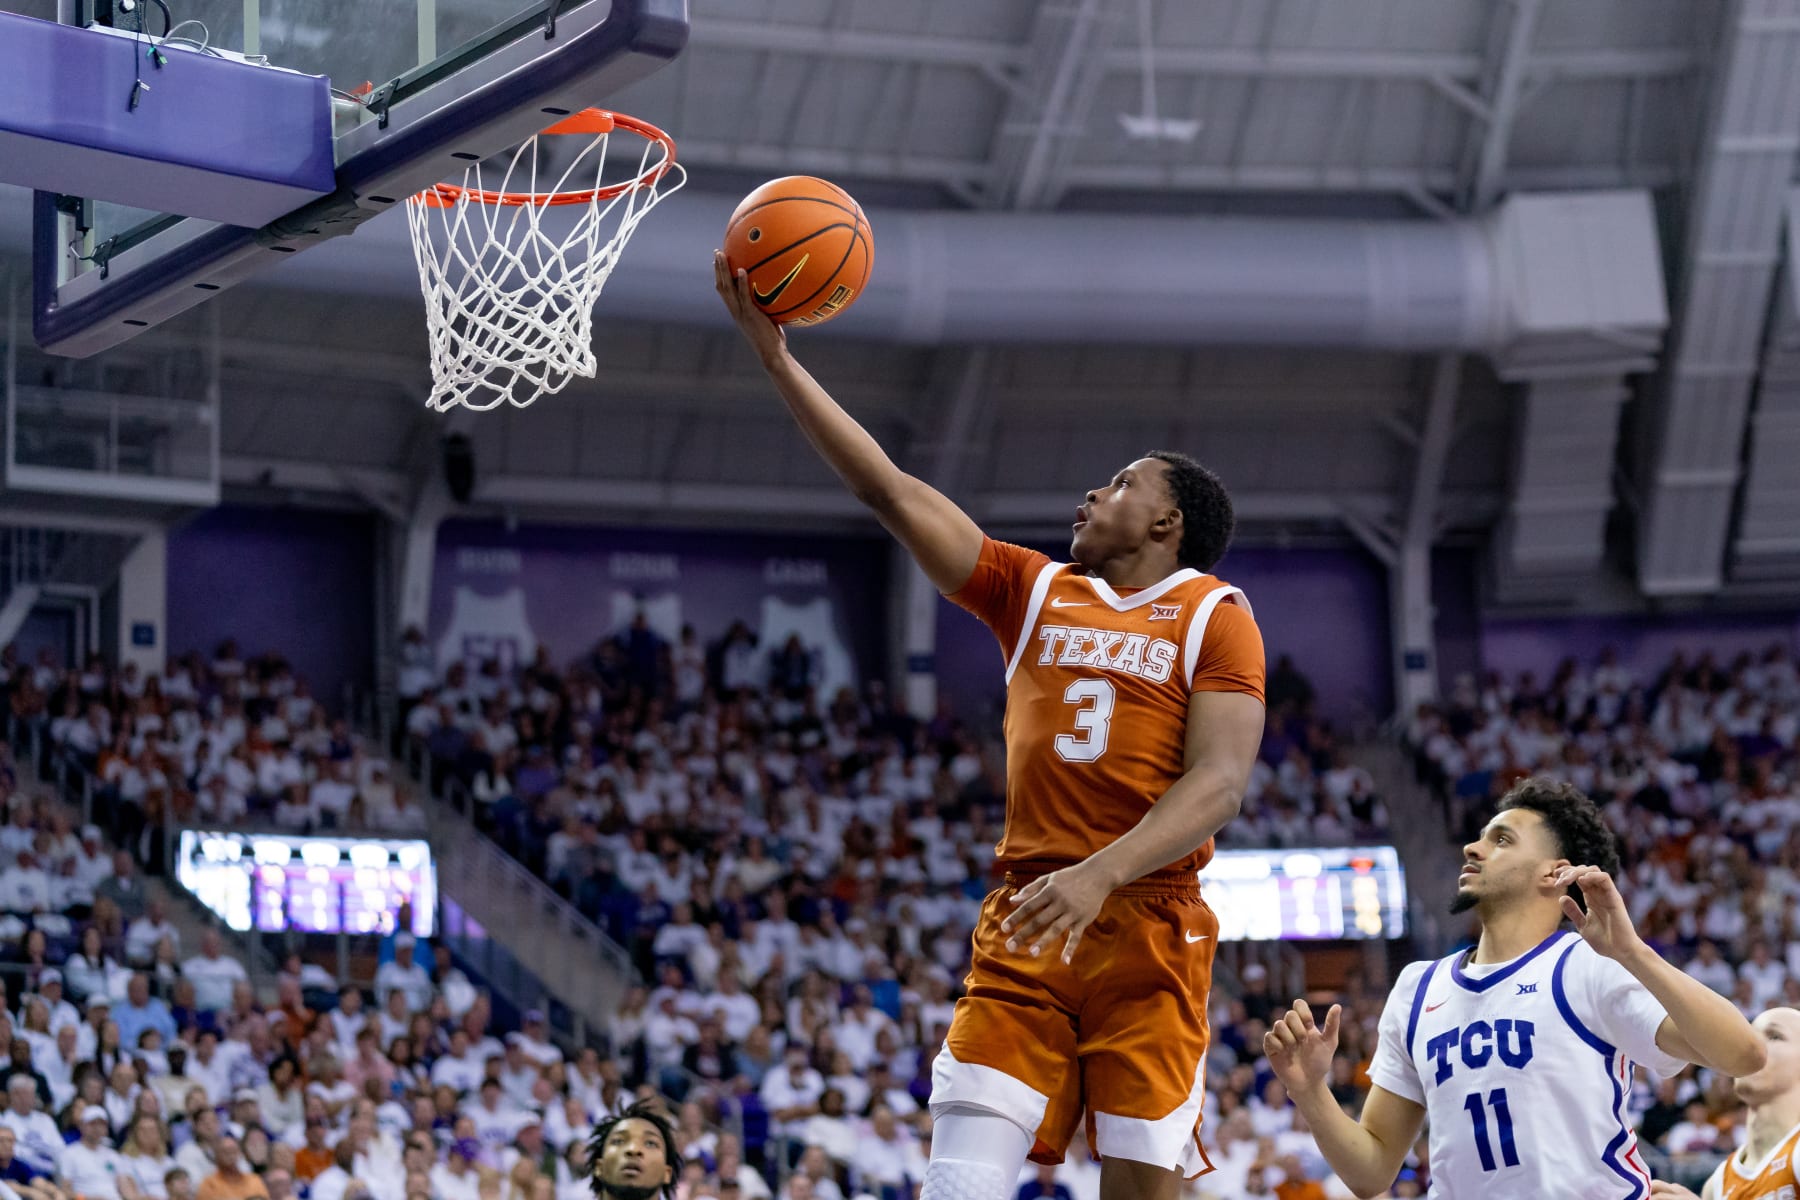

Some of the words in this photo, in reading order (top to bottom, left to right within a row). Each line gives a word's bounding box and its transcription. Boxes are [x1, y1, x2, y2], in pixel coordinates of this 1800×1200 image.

[1038, 625, 1178, 685] TEXAS
[1054, 678, 1116, 763] 3
[1427, 1018, 1535, 1087] TCU
[1464, 1087, 1520, 1171] 11
